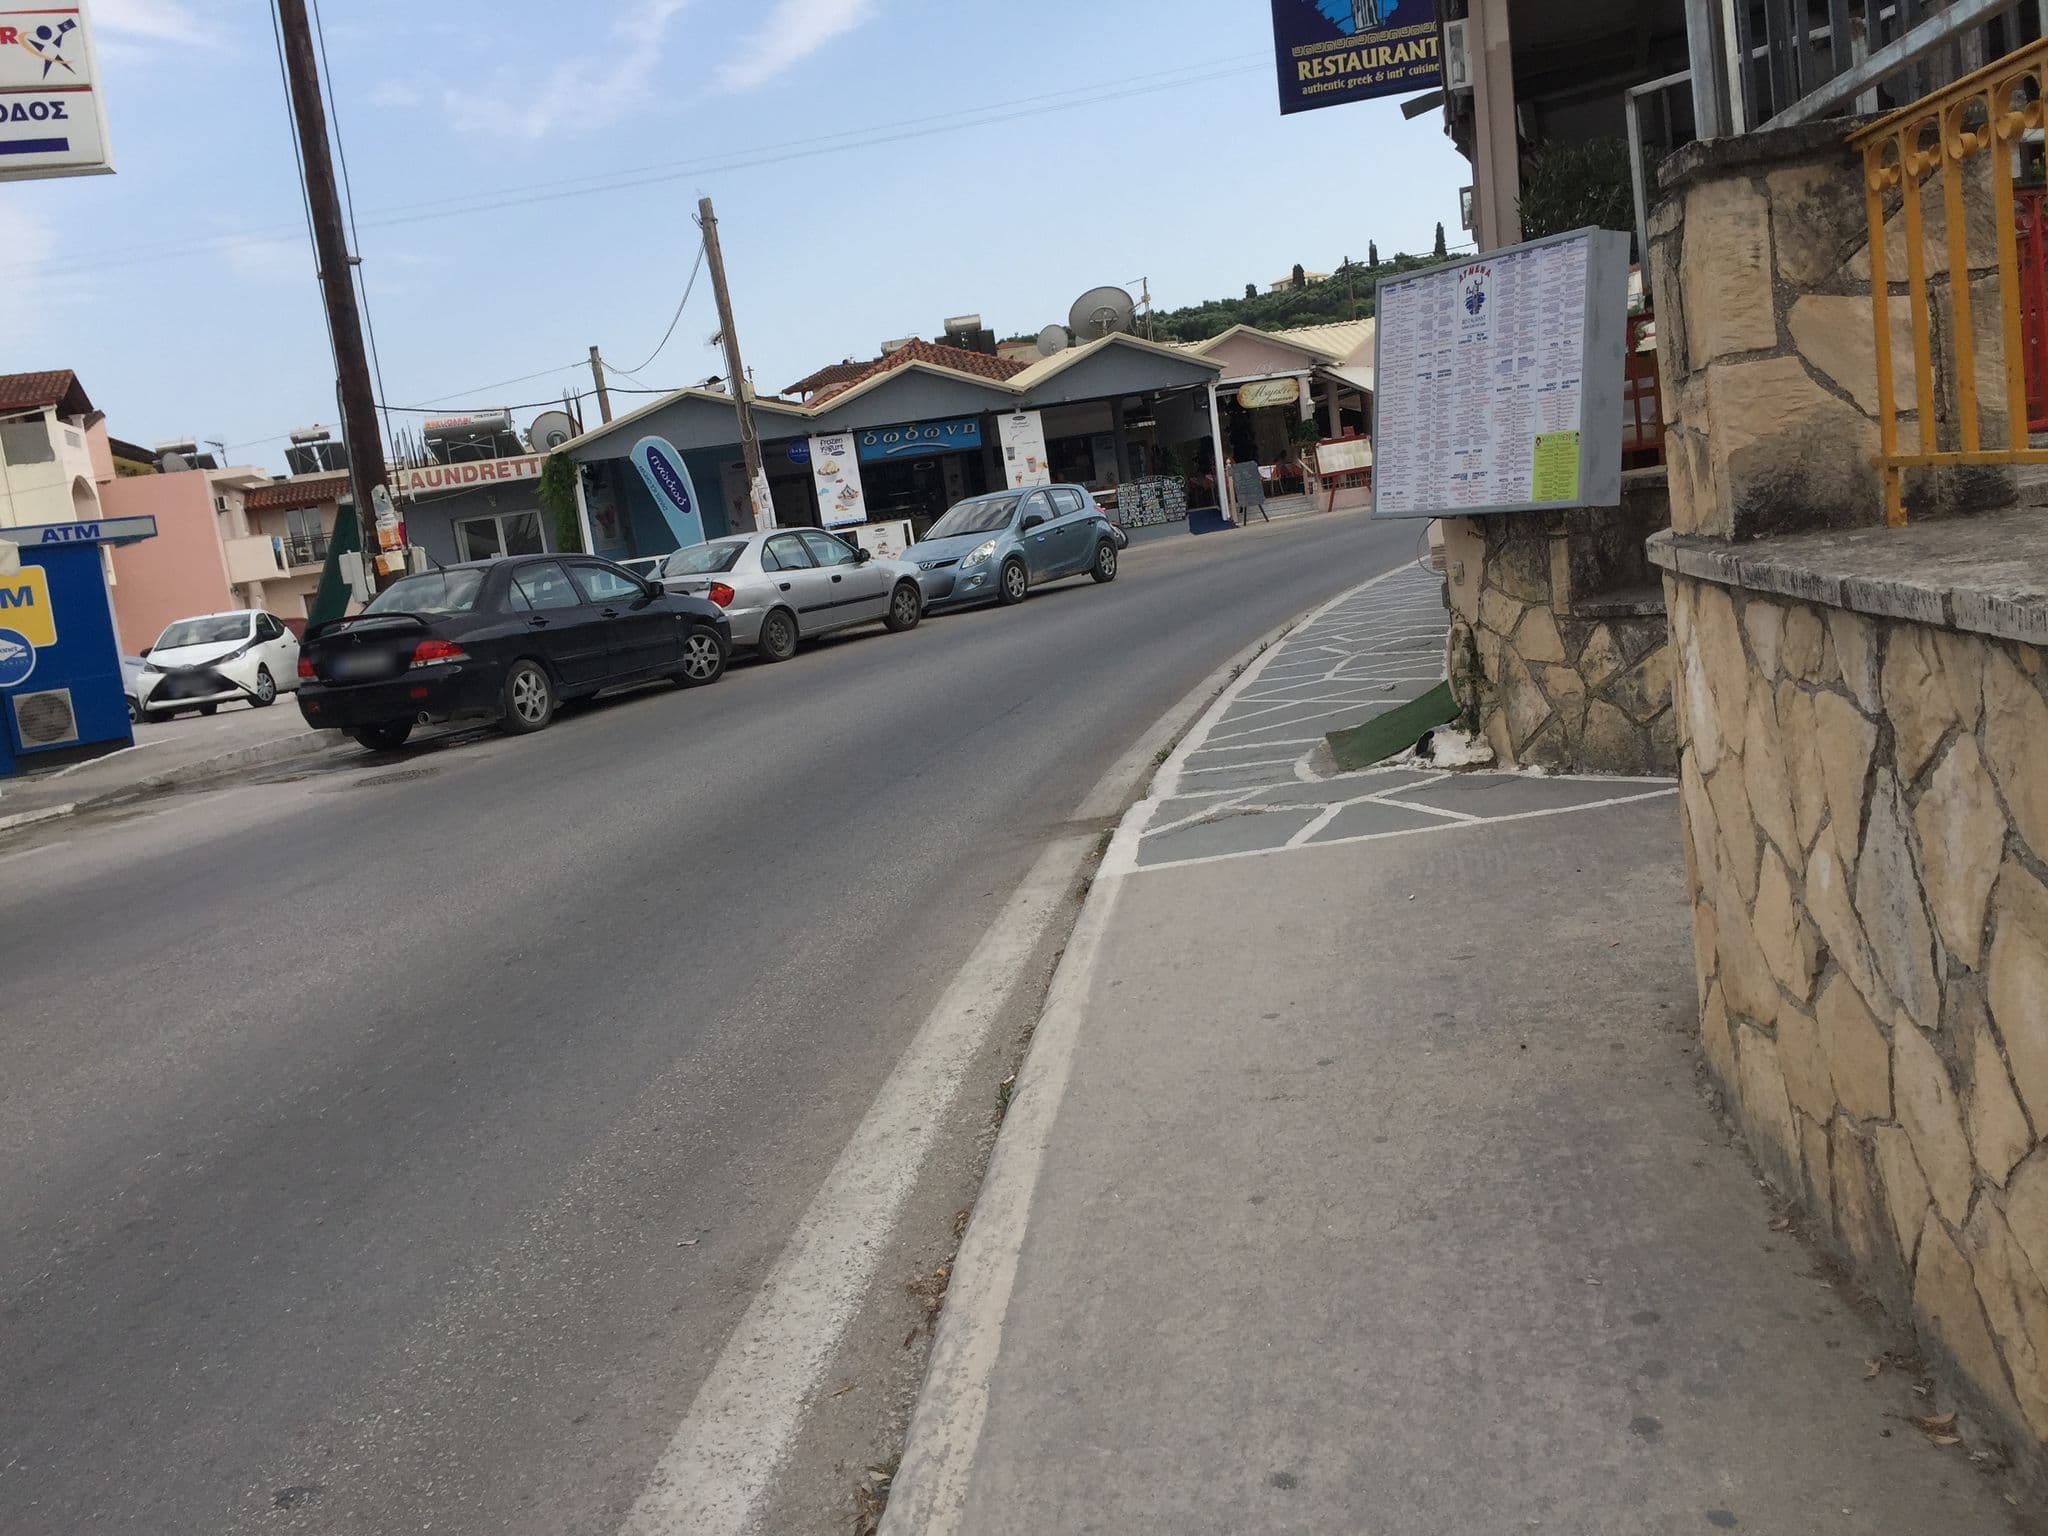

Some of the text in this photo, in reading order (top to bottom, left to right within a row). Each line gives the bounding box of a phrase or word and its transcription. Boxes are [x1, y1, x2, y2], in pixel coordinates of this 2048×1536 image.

[1297, 37, 1439, 81] RESTAURANT
[1302, 80, 1345, 95] authentic
[1347, 74, 1374, 89] greek
[1375, 71, 1384, 82] &
[1459, 265, 1491, 284] ATHENA
[395, 455, 549, 491] LAUNDRETT
[41, 524, 101, 543] ATM
